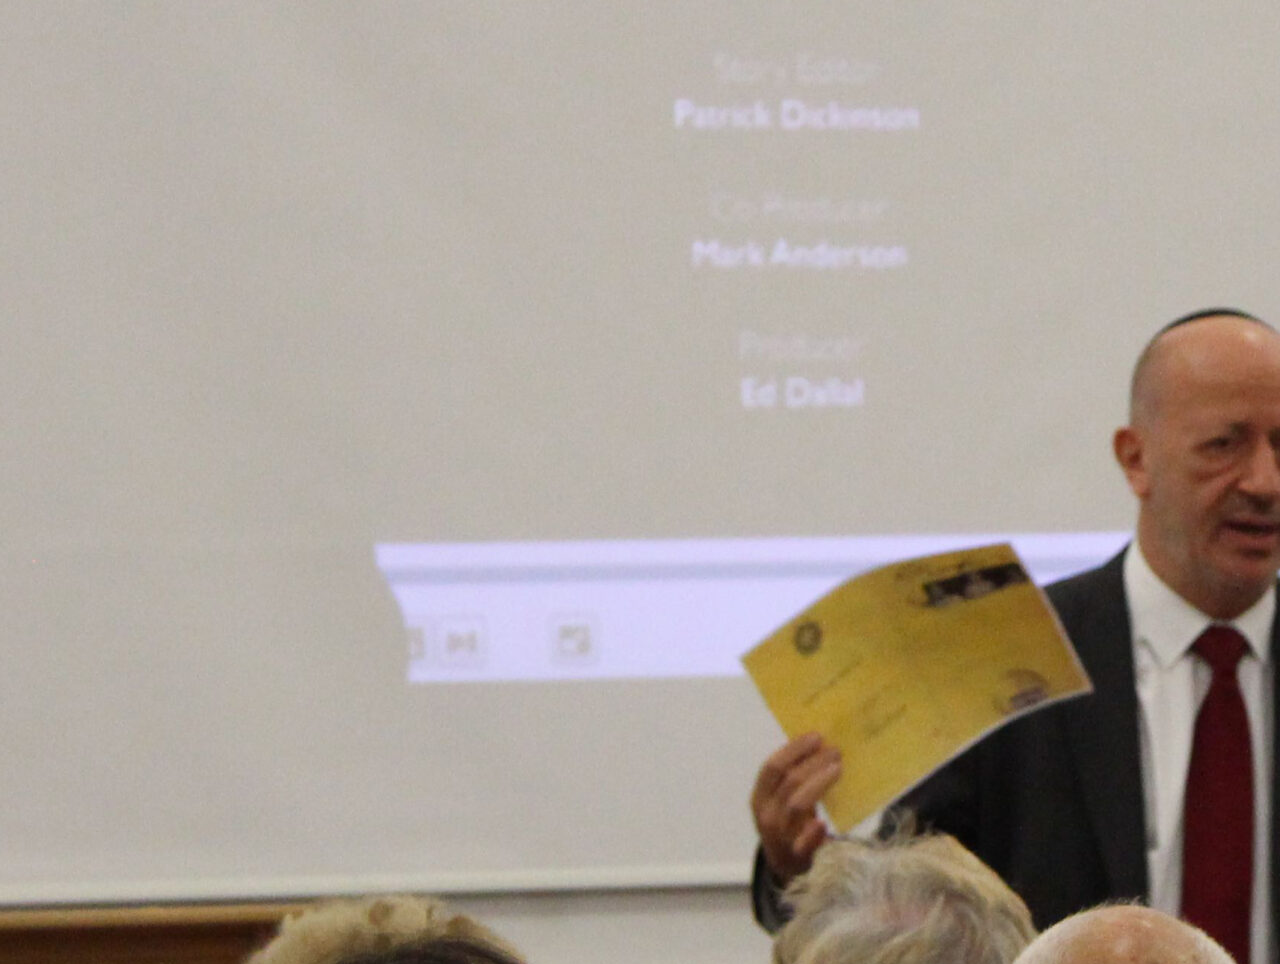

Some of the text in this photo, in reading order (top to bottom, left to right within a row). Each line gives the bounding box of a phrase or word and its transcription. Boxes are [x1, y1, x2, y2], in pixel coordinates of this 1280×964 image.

[674, 99, 920, 129] Patrick Dickinson
[692, 239, 908, 267] Mark Anderson
[741, 378, 777, 406] Ed
